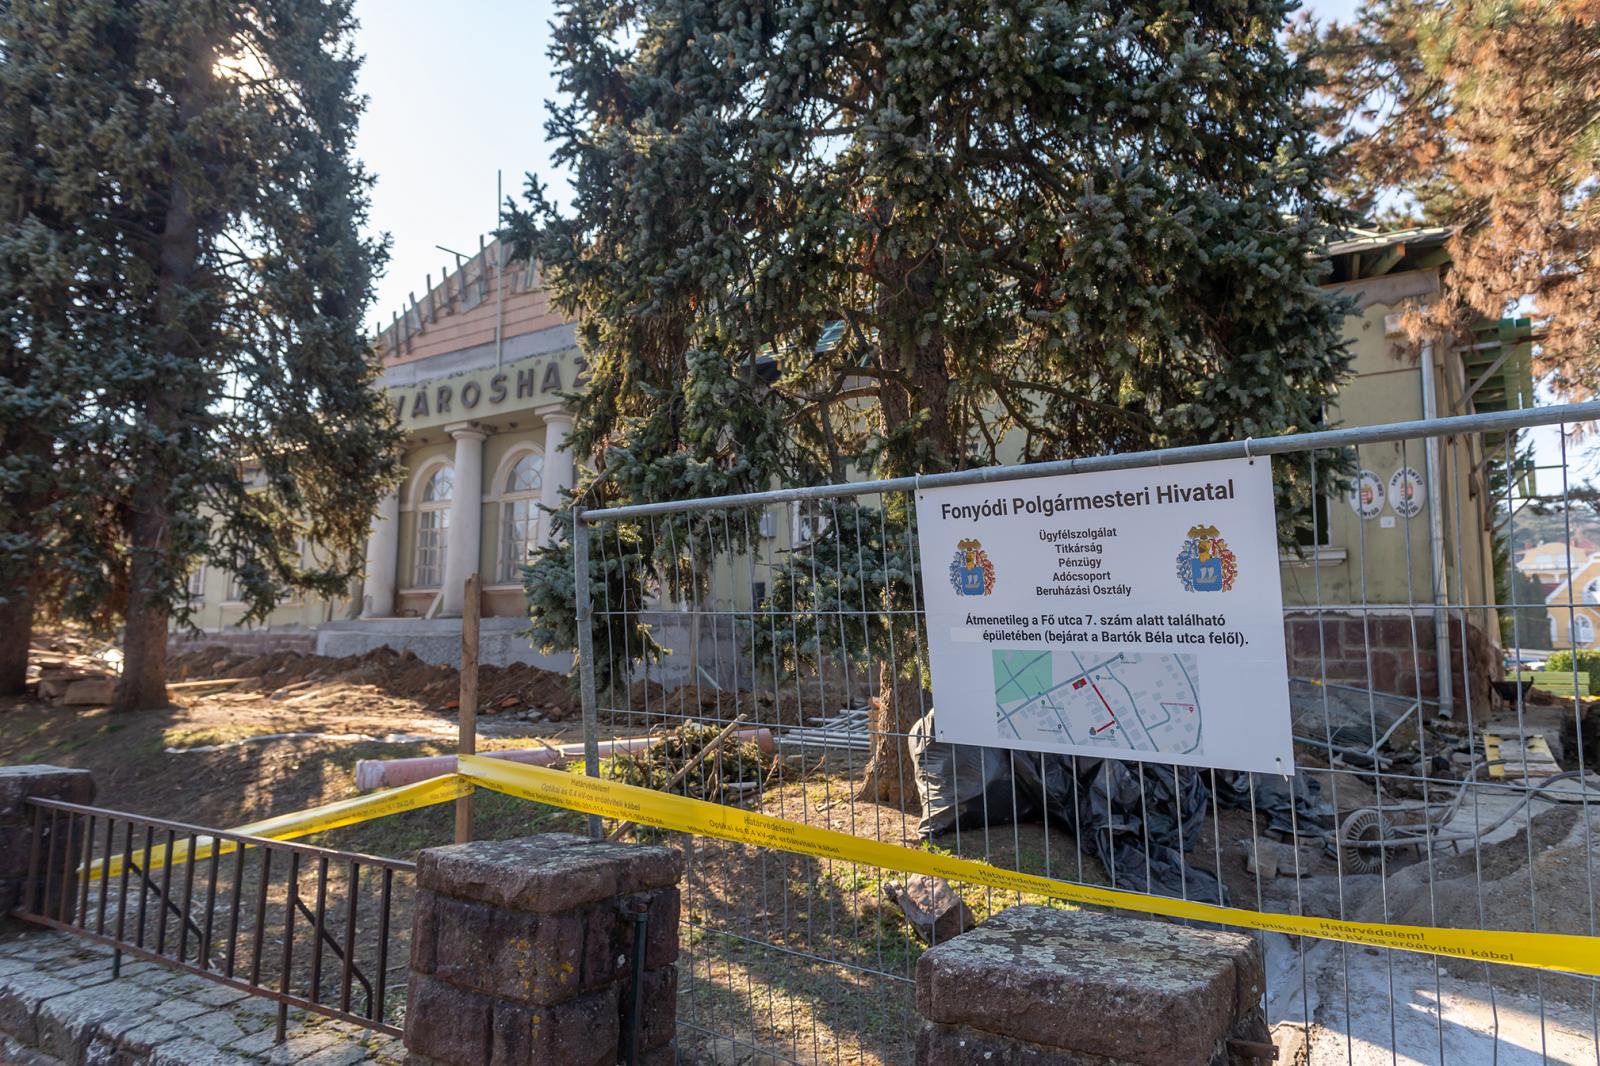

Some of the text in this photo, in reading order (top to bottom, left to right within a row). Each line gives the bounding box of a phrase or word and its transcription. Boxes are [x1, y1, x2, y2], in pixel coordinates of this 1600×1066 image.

[941, 479, 1234, 522] Fonyódi Polgármesteri Hivatal
[1039, 527, 1117, 542] Ügyfélszolgálat
[1054, 542, 1103, 554] Titkárság
[1058, 557, 1102, 568] Pénzügy
[1052, 571, 1111, 582] Adócsoport
[1036, 584, 1132, 596] Beruházási Osztály
[965, 612, 1226, 628] Átmenetileg a Fő utca 7. szám alatt található
[982, 629, 1249, 648] épületében (bejárat a Bartók Béla utca felől).
[1320, 922, 1425, 941] Határvédelem!
[1471, 949, 1514, 961] kábel
